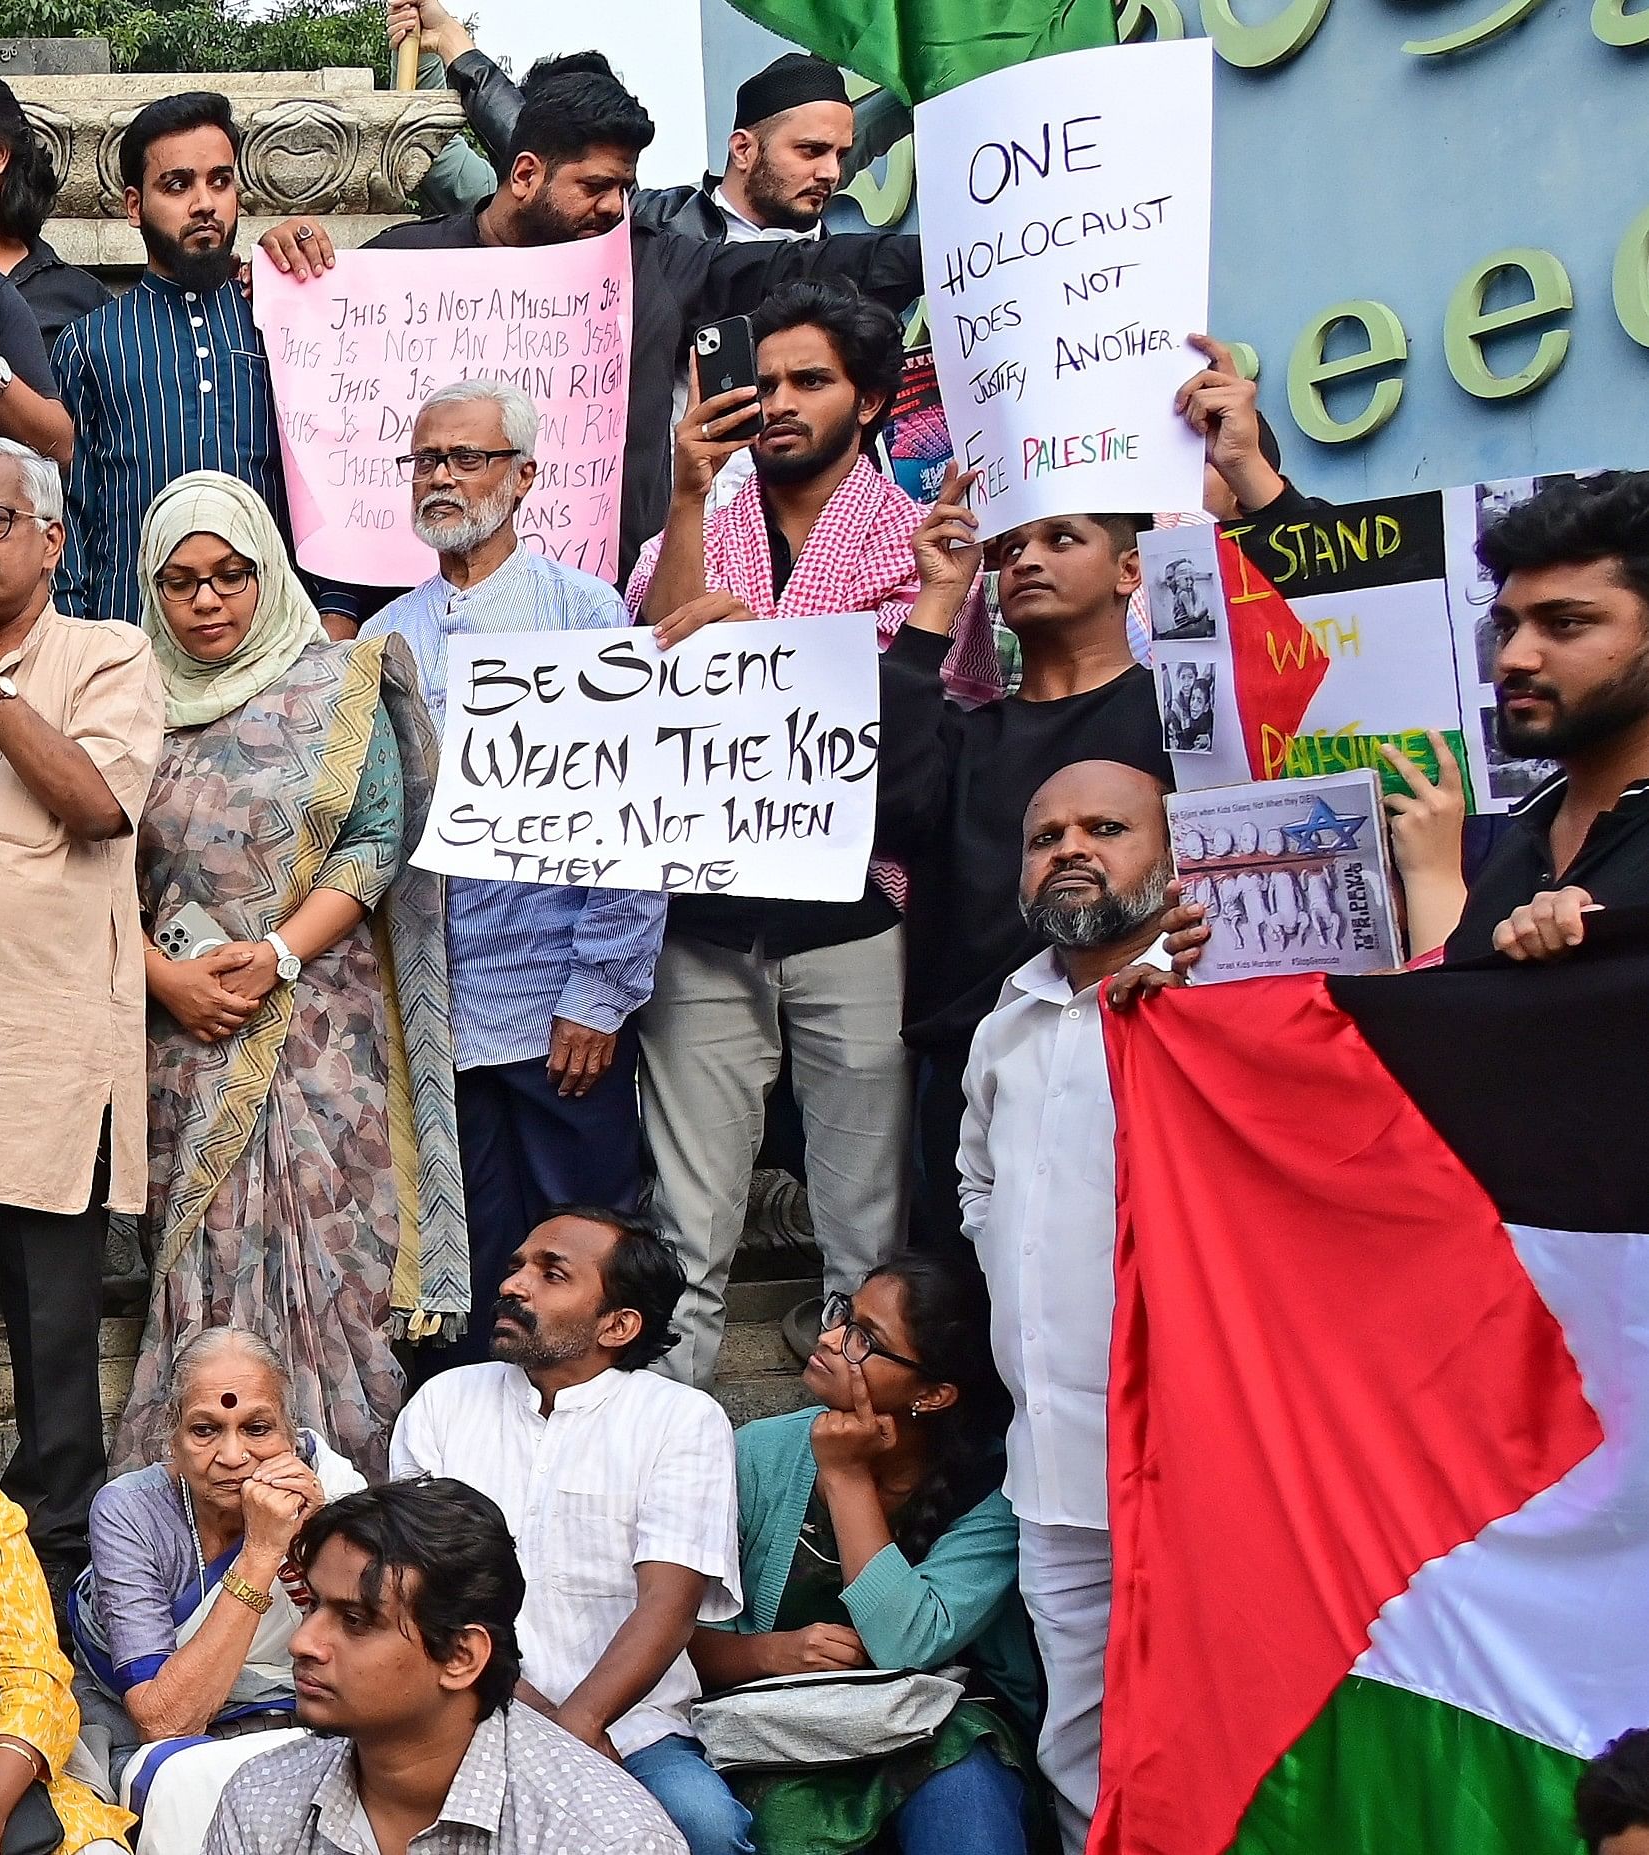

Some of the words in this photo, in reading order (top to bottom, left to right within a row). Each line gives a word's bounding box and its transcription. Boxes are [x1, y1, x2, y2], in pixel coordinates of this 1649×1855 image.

[968, 115, 1103, 205] ONE
[940, 195, 1173, 298] HOLOCAUST
[330, 298, 387, 330] THIS
[405, 291, 428, 325] IS
[437, 290, 483, 322] NOT
[487, 288, 505, 320] A
[511, 289, 590, 319] MUSLIM
[954, 300, 1023, 360] DOES
[1062, 263, 1141, 306] NOT
[280, 327, 322, 368] THIS
[333, 331, 359, 367] IS
[384, 329, 437, 363] NOT
[450, 326, 488, 361] AN
[503, 322, 569, 361] ARAB
[328, 372, 380, 403] THIS
[969, 360, 1029, 405] JUSTIFY
[963, 428, 1009, 511] FREE
[1022, 426, 1141, 481] PALESTINE
[345, 498, 395, 529] AND
[1218, 524, 1272, 605] I
[1268, 513, 1402, 583] STAND
[1265, 616, 1362, 675] WITH
[462, 658, 565, 717] BE
[460, 720, 630, 791] WHEN
[655, 722, 772, 787] THE
[784, 706, 881, 786] KIDS
[618, 796, 706, 849] NOT
[721, 796, 835, 845] WHEN
[493, 848, 622, 886] THEY
[660, 859, 739, 893] DIE
